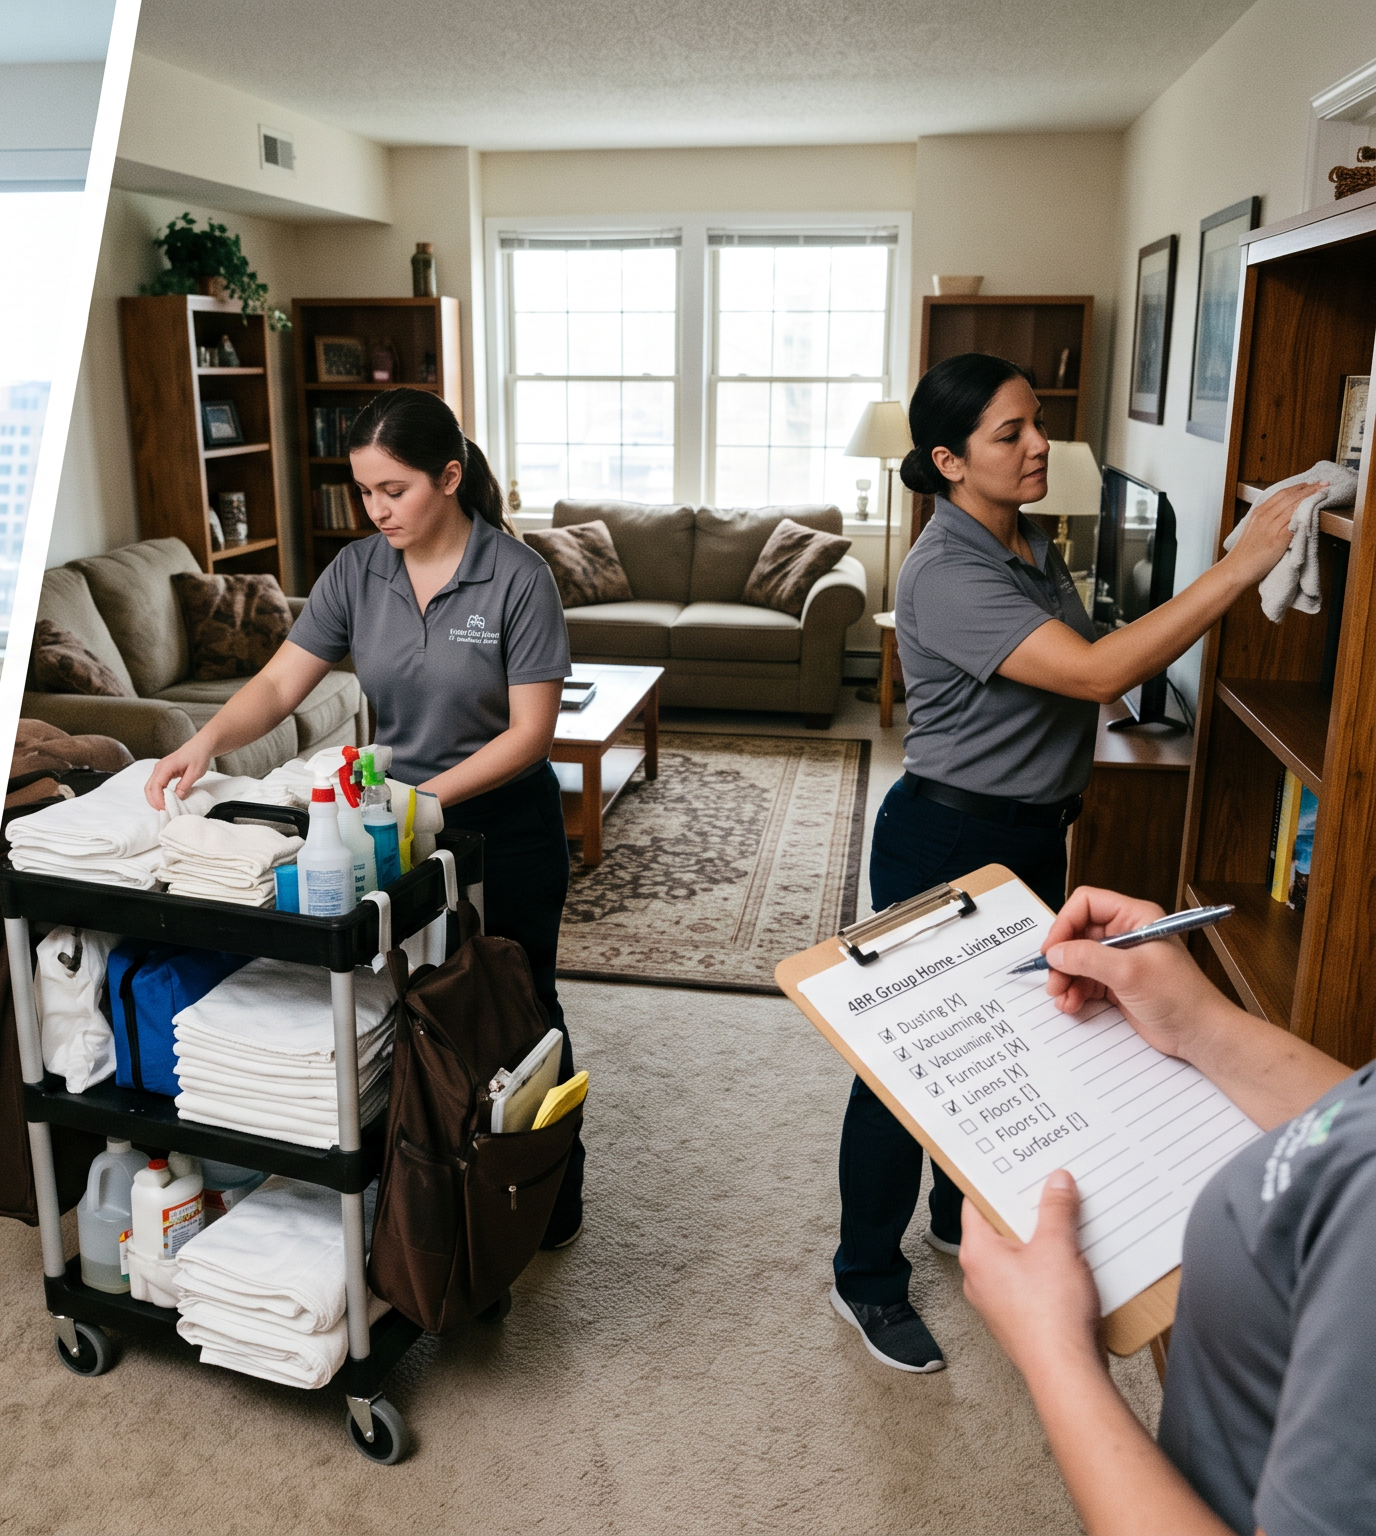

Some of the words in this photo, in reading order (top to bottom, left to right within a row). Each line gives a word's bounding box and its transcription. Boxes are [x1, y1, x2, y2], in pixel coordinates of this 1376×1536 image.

[847, 993, 876, 1014] 4BR
[875, 976, 918, 1000] Group
[915, 956, 956, 979] Home
[961, 931, 1002, 957] Living
[996, 916, 1035, 939] Room
[897, 1005, 948, 1034] Dusting
[943, 993, 968, 1013] [X]
[911, 1011, 987, 1051] Vacuuming
[980, 999, 1005, 1019] [X]
[962, 1077, 1007, 1105] Linens
[1002, 1062, 1029, 1083] [X]
[979, 1095, 1022, 1124] Floors
[995, 1114, 1038, 1142] Floors
[1012, 1124, 1070, 1162] Surfaces
